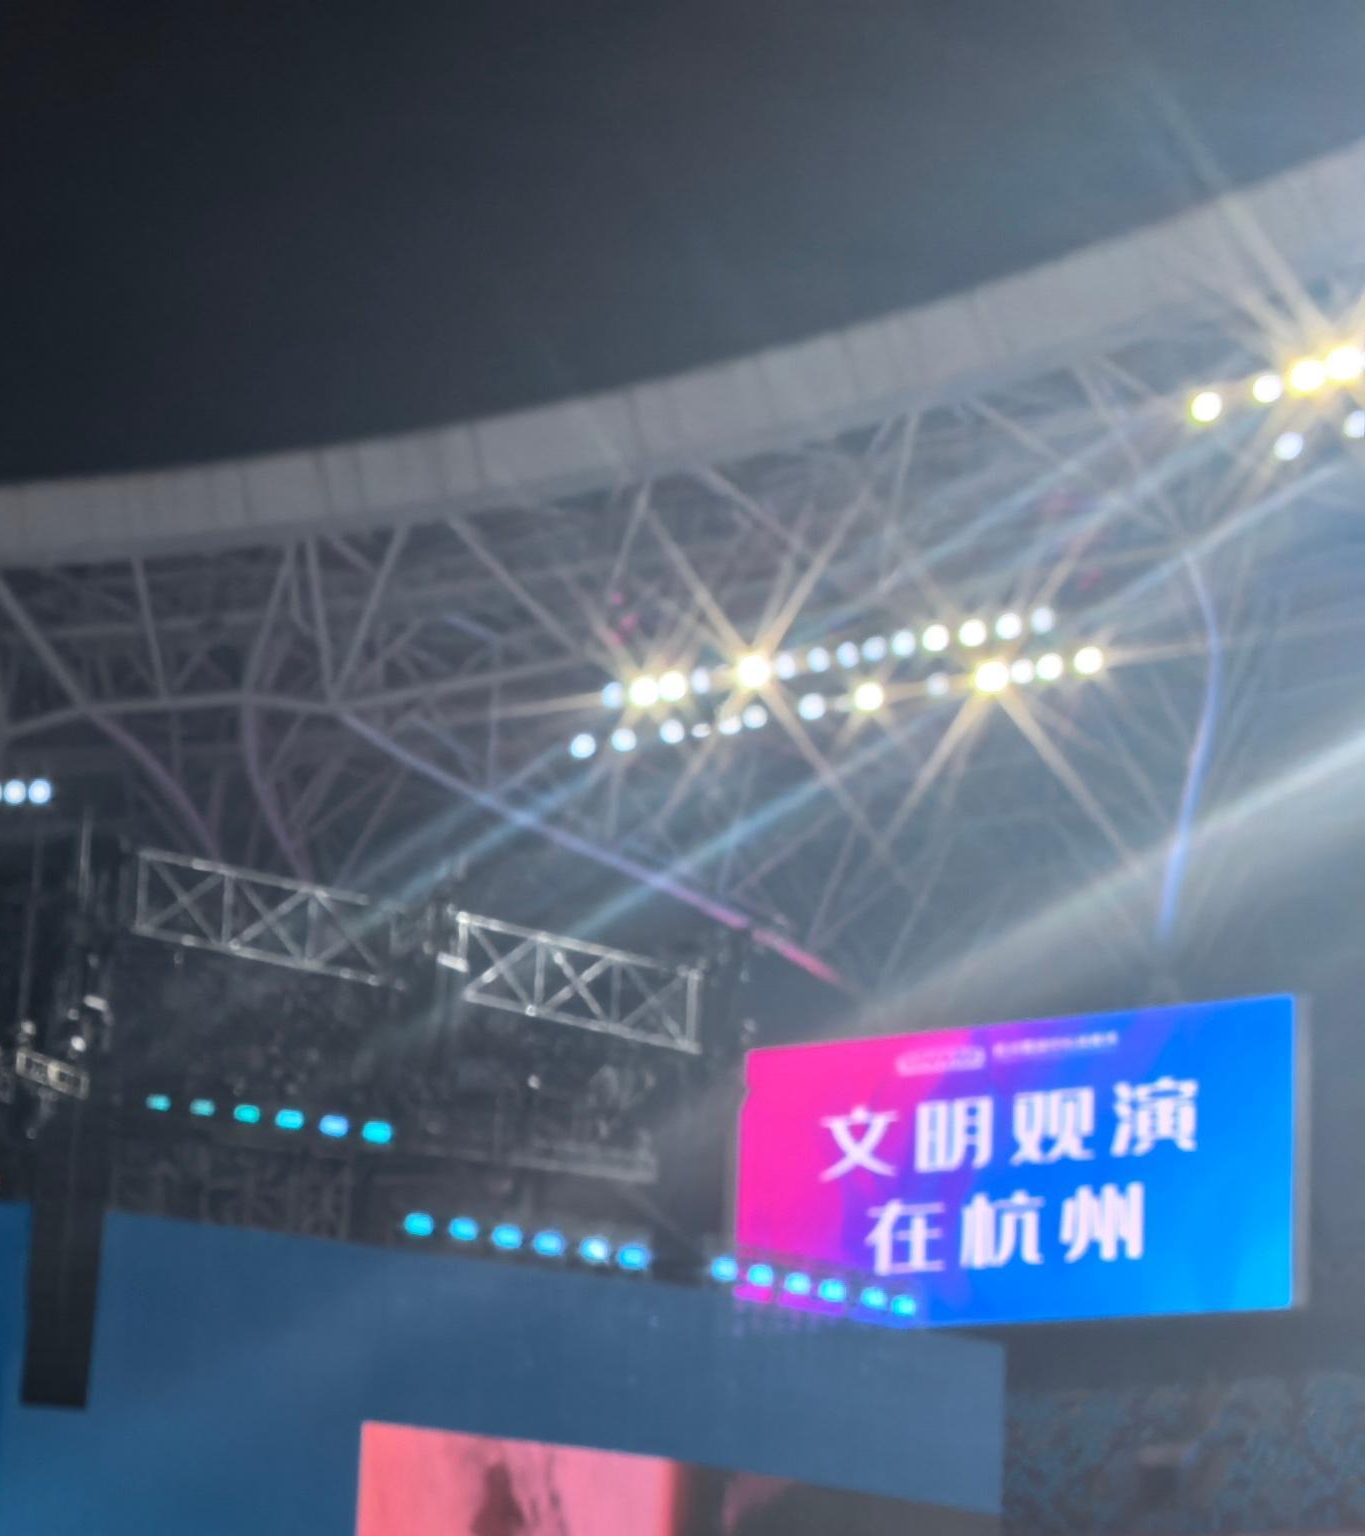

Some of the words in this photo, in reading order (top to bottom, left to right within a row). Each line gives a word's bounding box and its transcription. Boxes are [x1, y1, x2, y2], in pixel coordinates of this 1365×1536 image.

[818, 1077, 1198, 1183] 文明观演
[865, 1182, 1144, 1276] 在杭州
